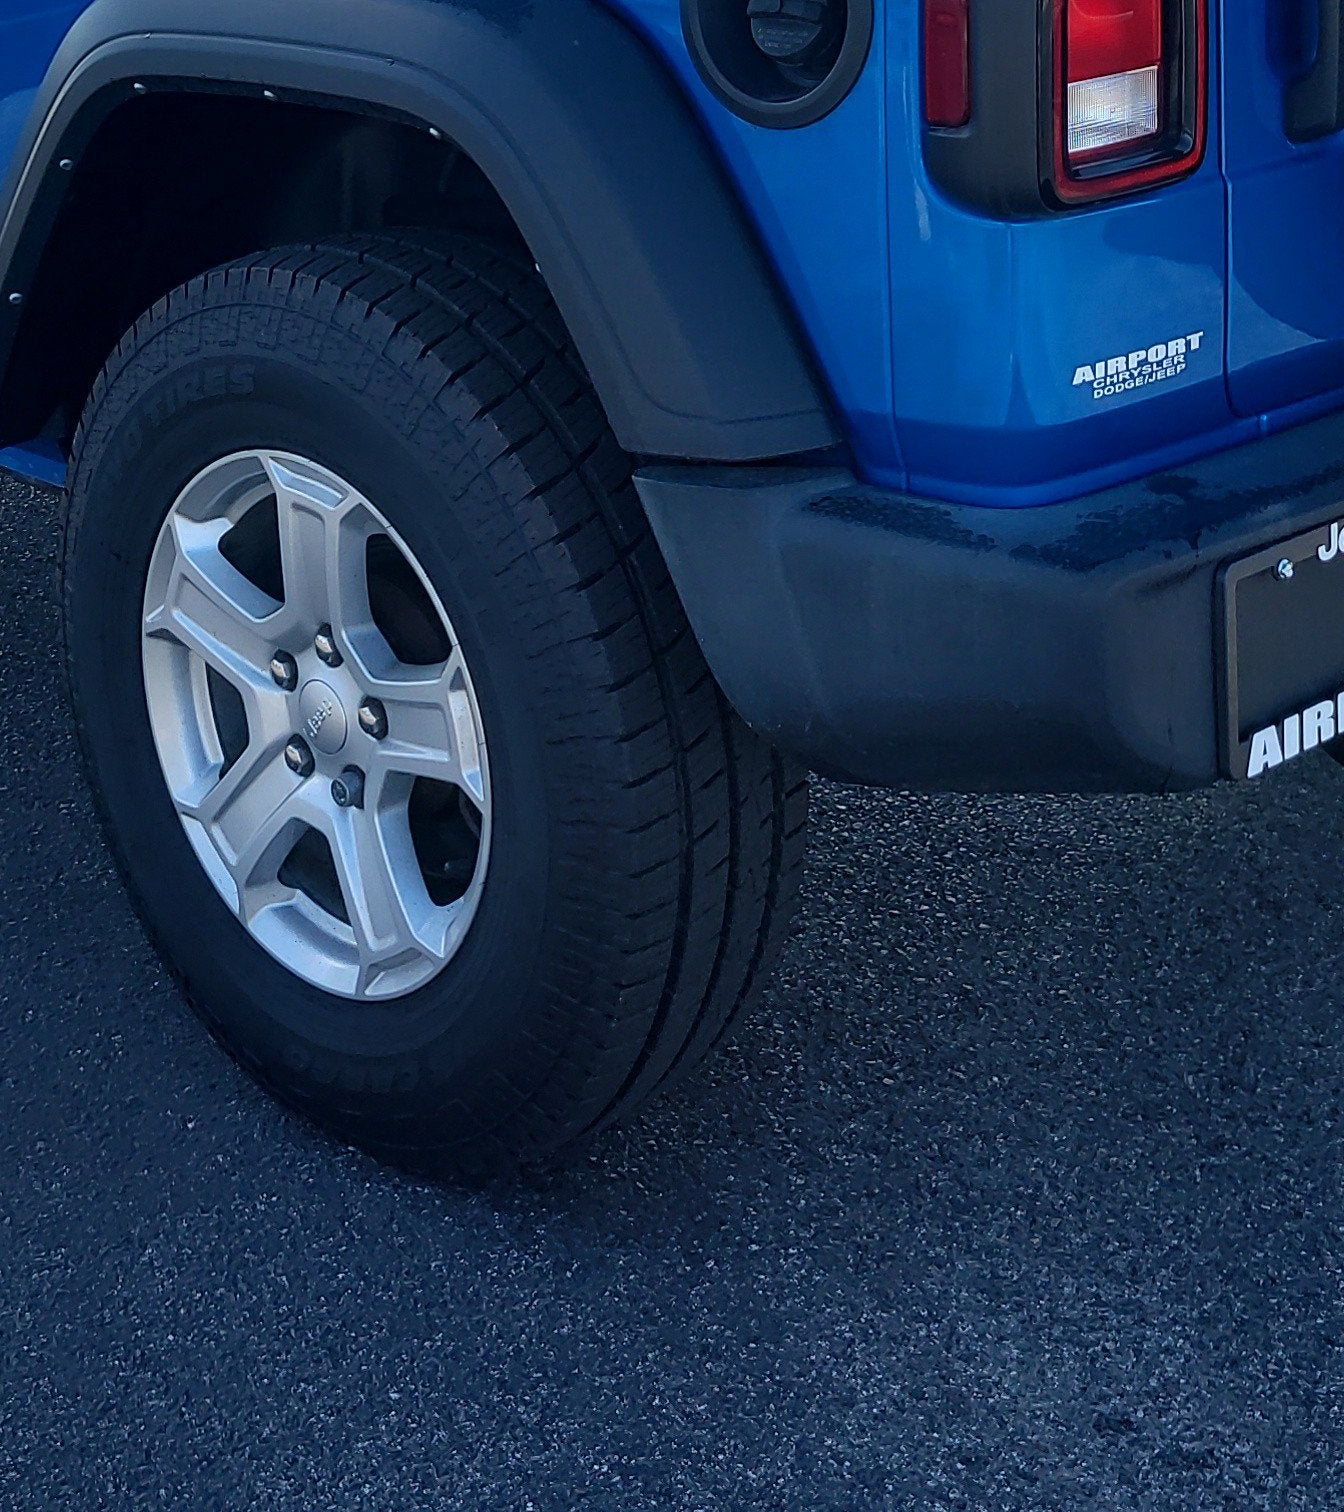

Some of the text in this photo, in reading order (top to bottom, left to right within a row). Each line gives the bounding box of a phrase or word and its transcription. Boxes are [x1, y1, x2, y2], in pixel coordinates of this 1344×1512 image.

[1071, 331, 1204, 386] AIRPORT
[1092, 354, 1185, 389] CHRYSLER
[1093, 363, 1186, 399] DODGE/JEEP
